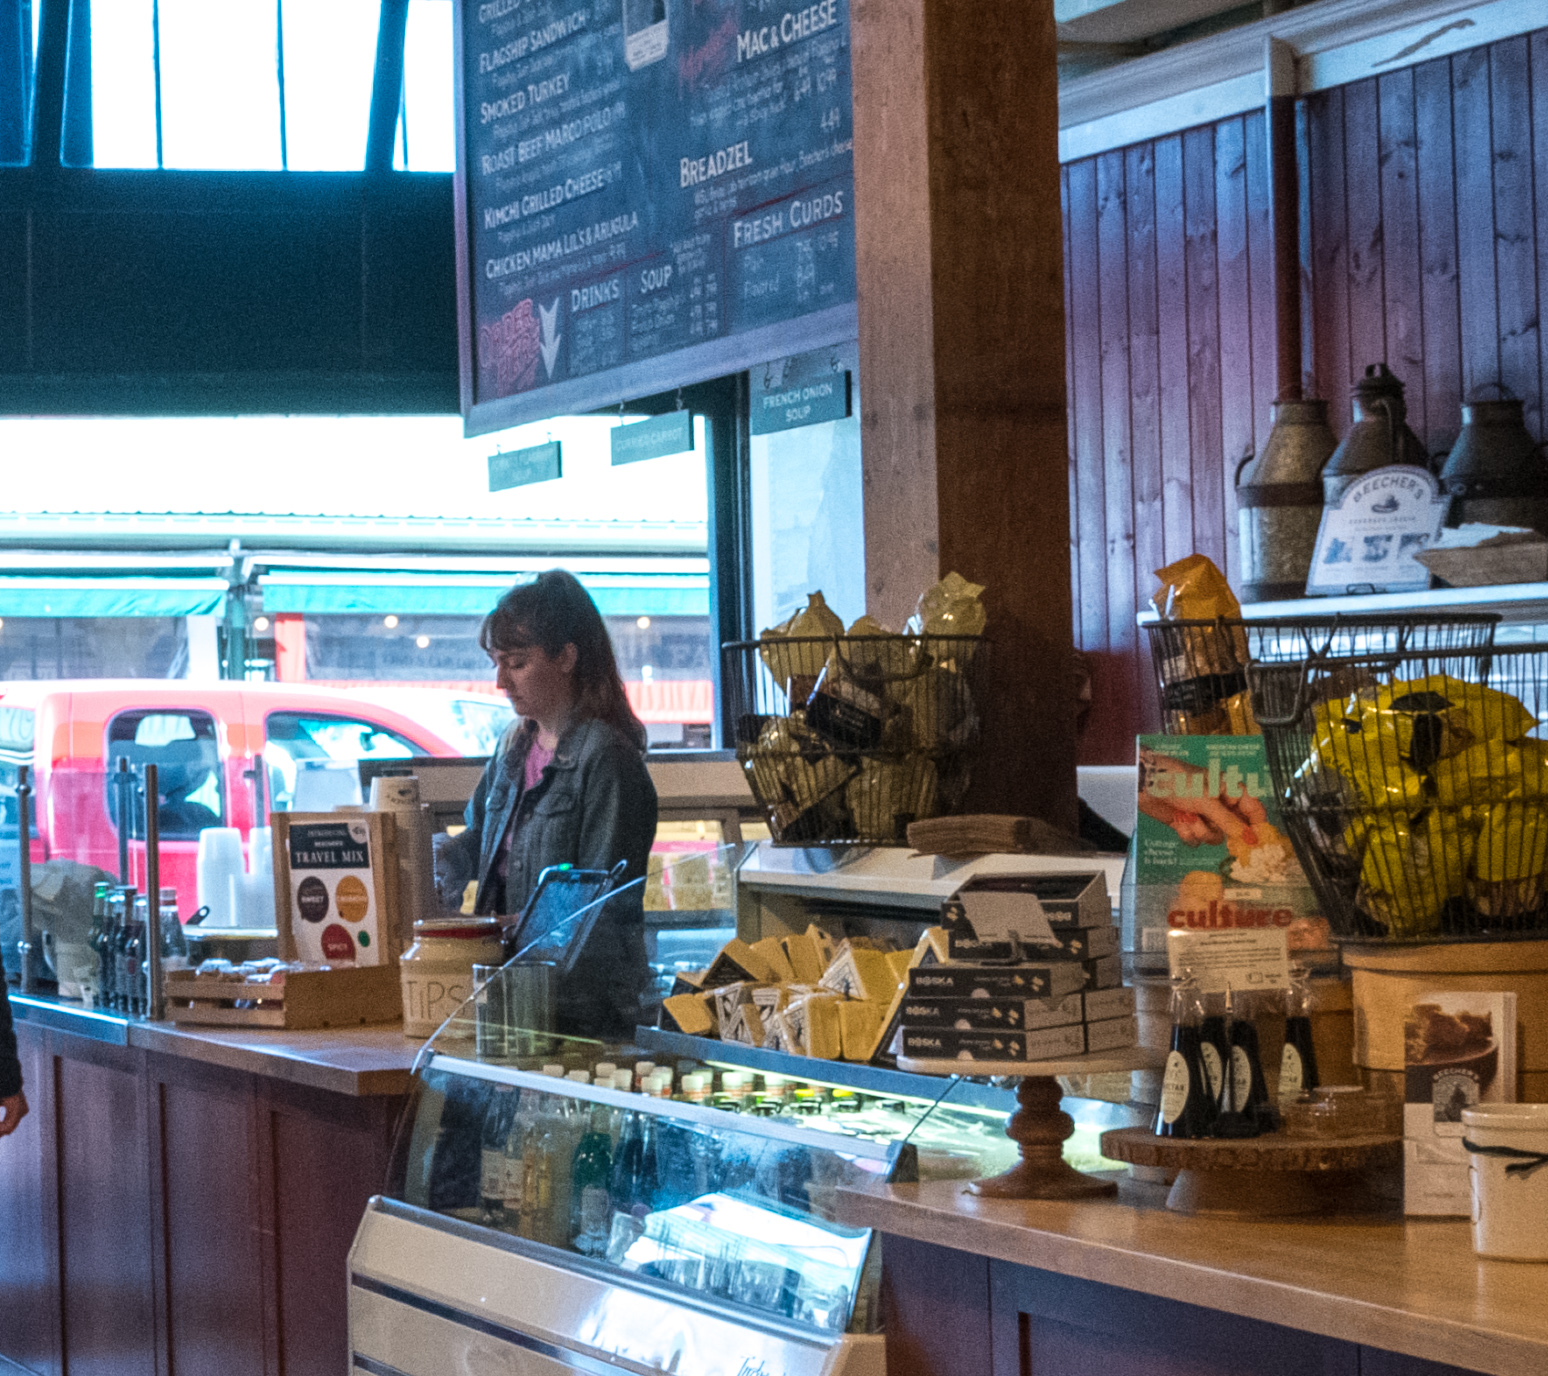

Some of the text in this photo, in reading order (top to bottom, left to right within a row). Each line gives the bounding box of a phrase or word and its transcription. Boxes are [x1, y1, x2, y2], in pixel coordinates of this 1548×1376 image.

[479, 35, 529, 73] FLAGSHIP
[531, 9, 586, 51] SANDWICH
[737, 30, 768, 63] MAC
[770, 26, 779, 48] &
[481, 92, 525, 124] SMOKED
[528, 73, 570, 105] TURKEY
[482, 147, 515, 176] ROAST
[518, 136, 543, 162] BEEF
[545, 120, 582, 151] MARCO
[680, 140, 752, 188] BREADZEL
[484, 201, 520, 229] KIMCHI
[522, 185, 564, 216] GRILLED
[565, 168, 604, 199] CHEESE
[734, 191, 844, 248] FRESH CURDS
[486, 249, 531, 279] CHICKEN
[532, 241, 563, 264] MAMA
[594, 211, 639, 244] ARUGULA
[571, 279, 619, 312] DRINKS
[641, 265, 672, 294] SOUP
[763, 383, 833, 409] FRENCH ONION
[785, 407, 811, 423] SOUP
[1354, 476, 1424, 502] BEECHER'S
[295, 850, 365, 864] TRAVEL MIX
[1167, 900, 1294, 928] culture
